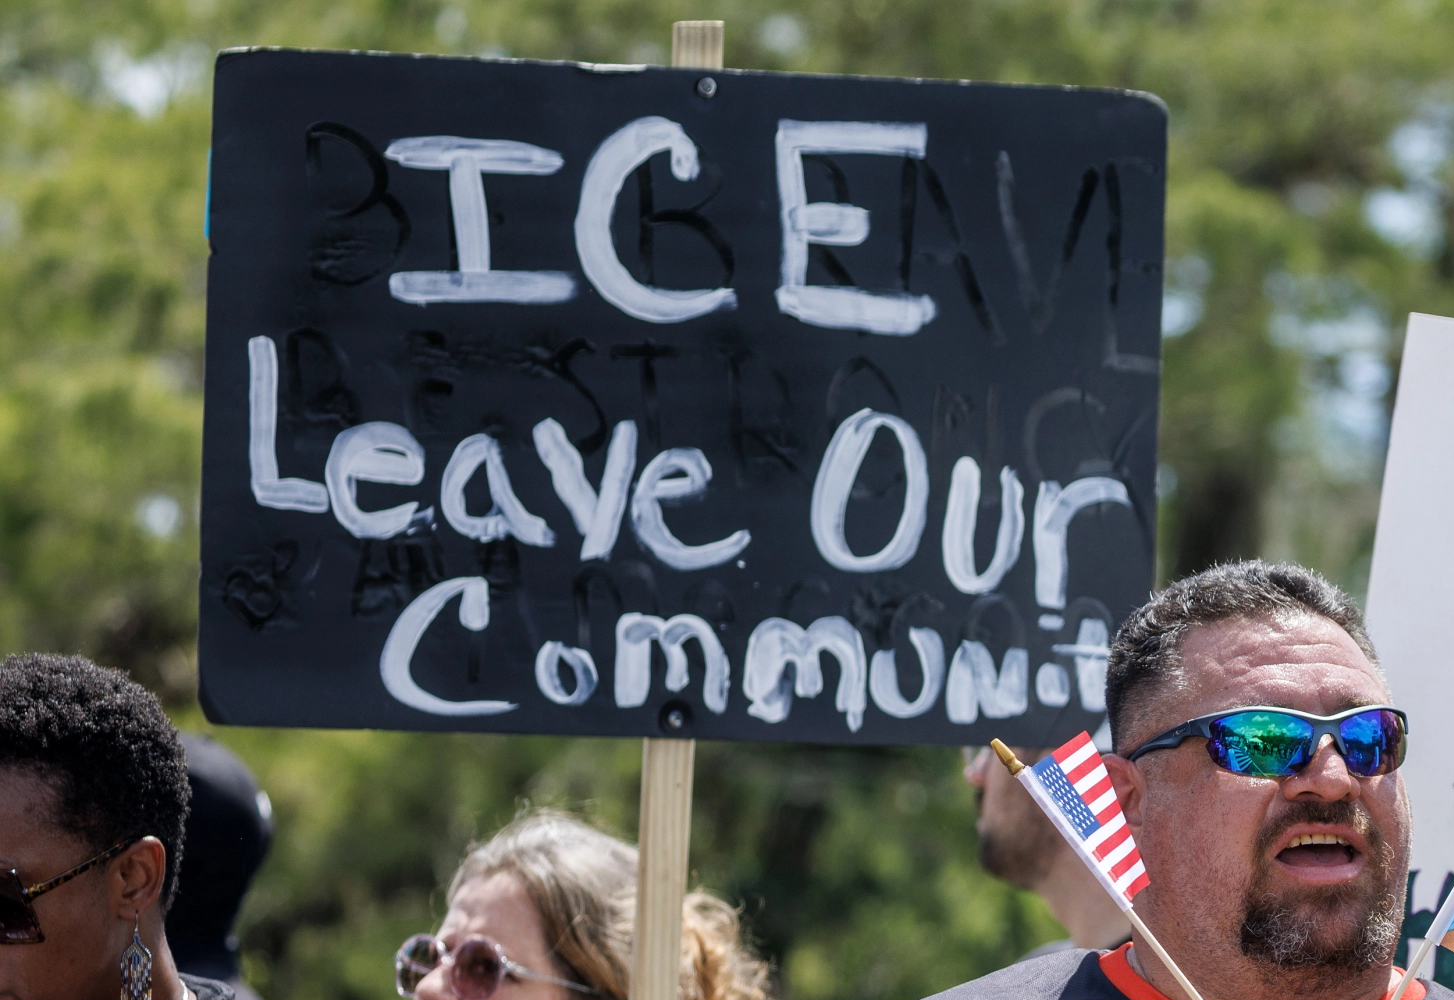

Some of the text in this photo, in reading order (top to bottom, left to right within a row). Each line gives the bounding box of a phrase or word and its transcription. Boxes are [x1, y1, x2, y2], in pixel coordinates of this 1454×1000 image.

[384, 116, 936, 336] ICE
[248, 336, 1133, 609] Leave Our
[379, 577, 1113, 740] Communit
